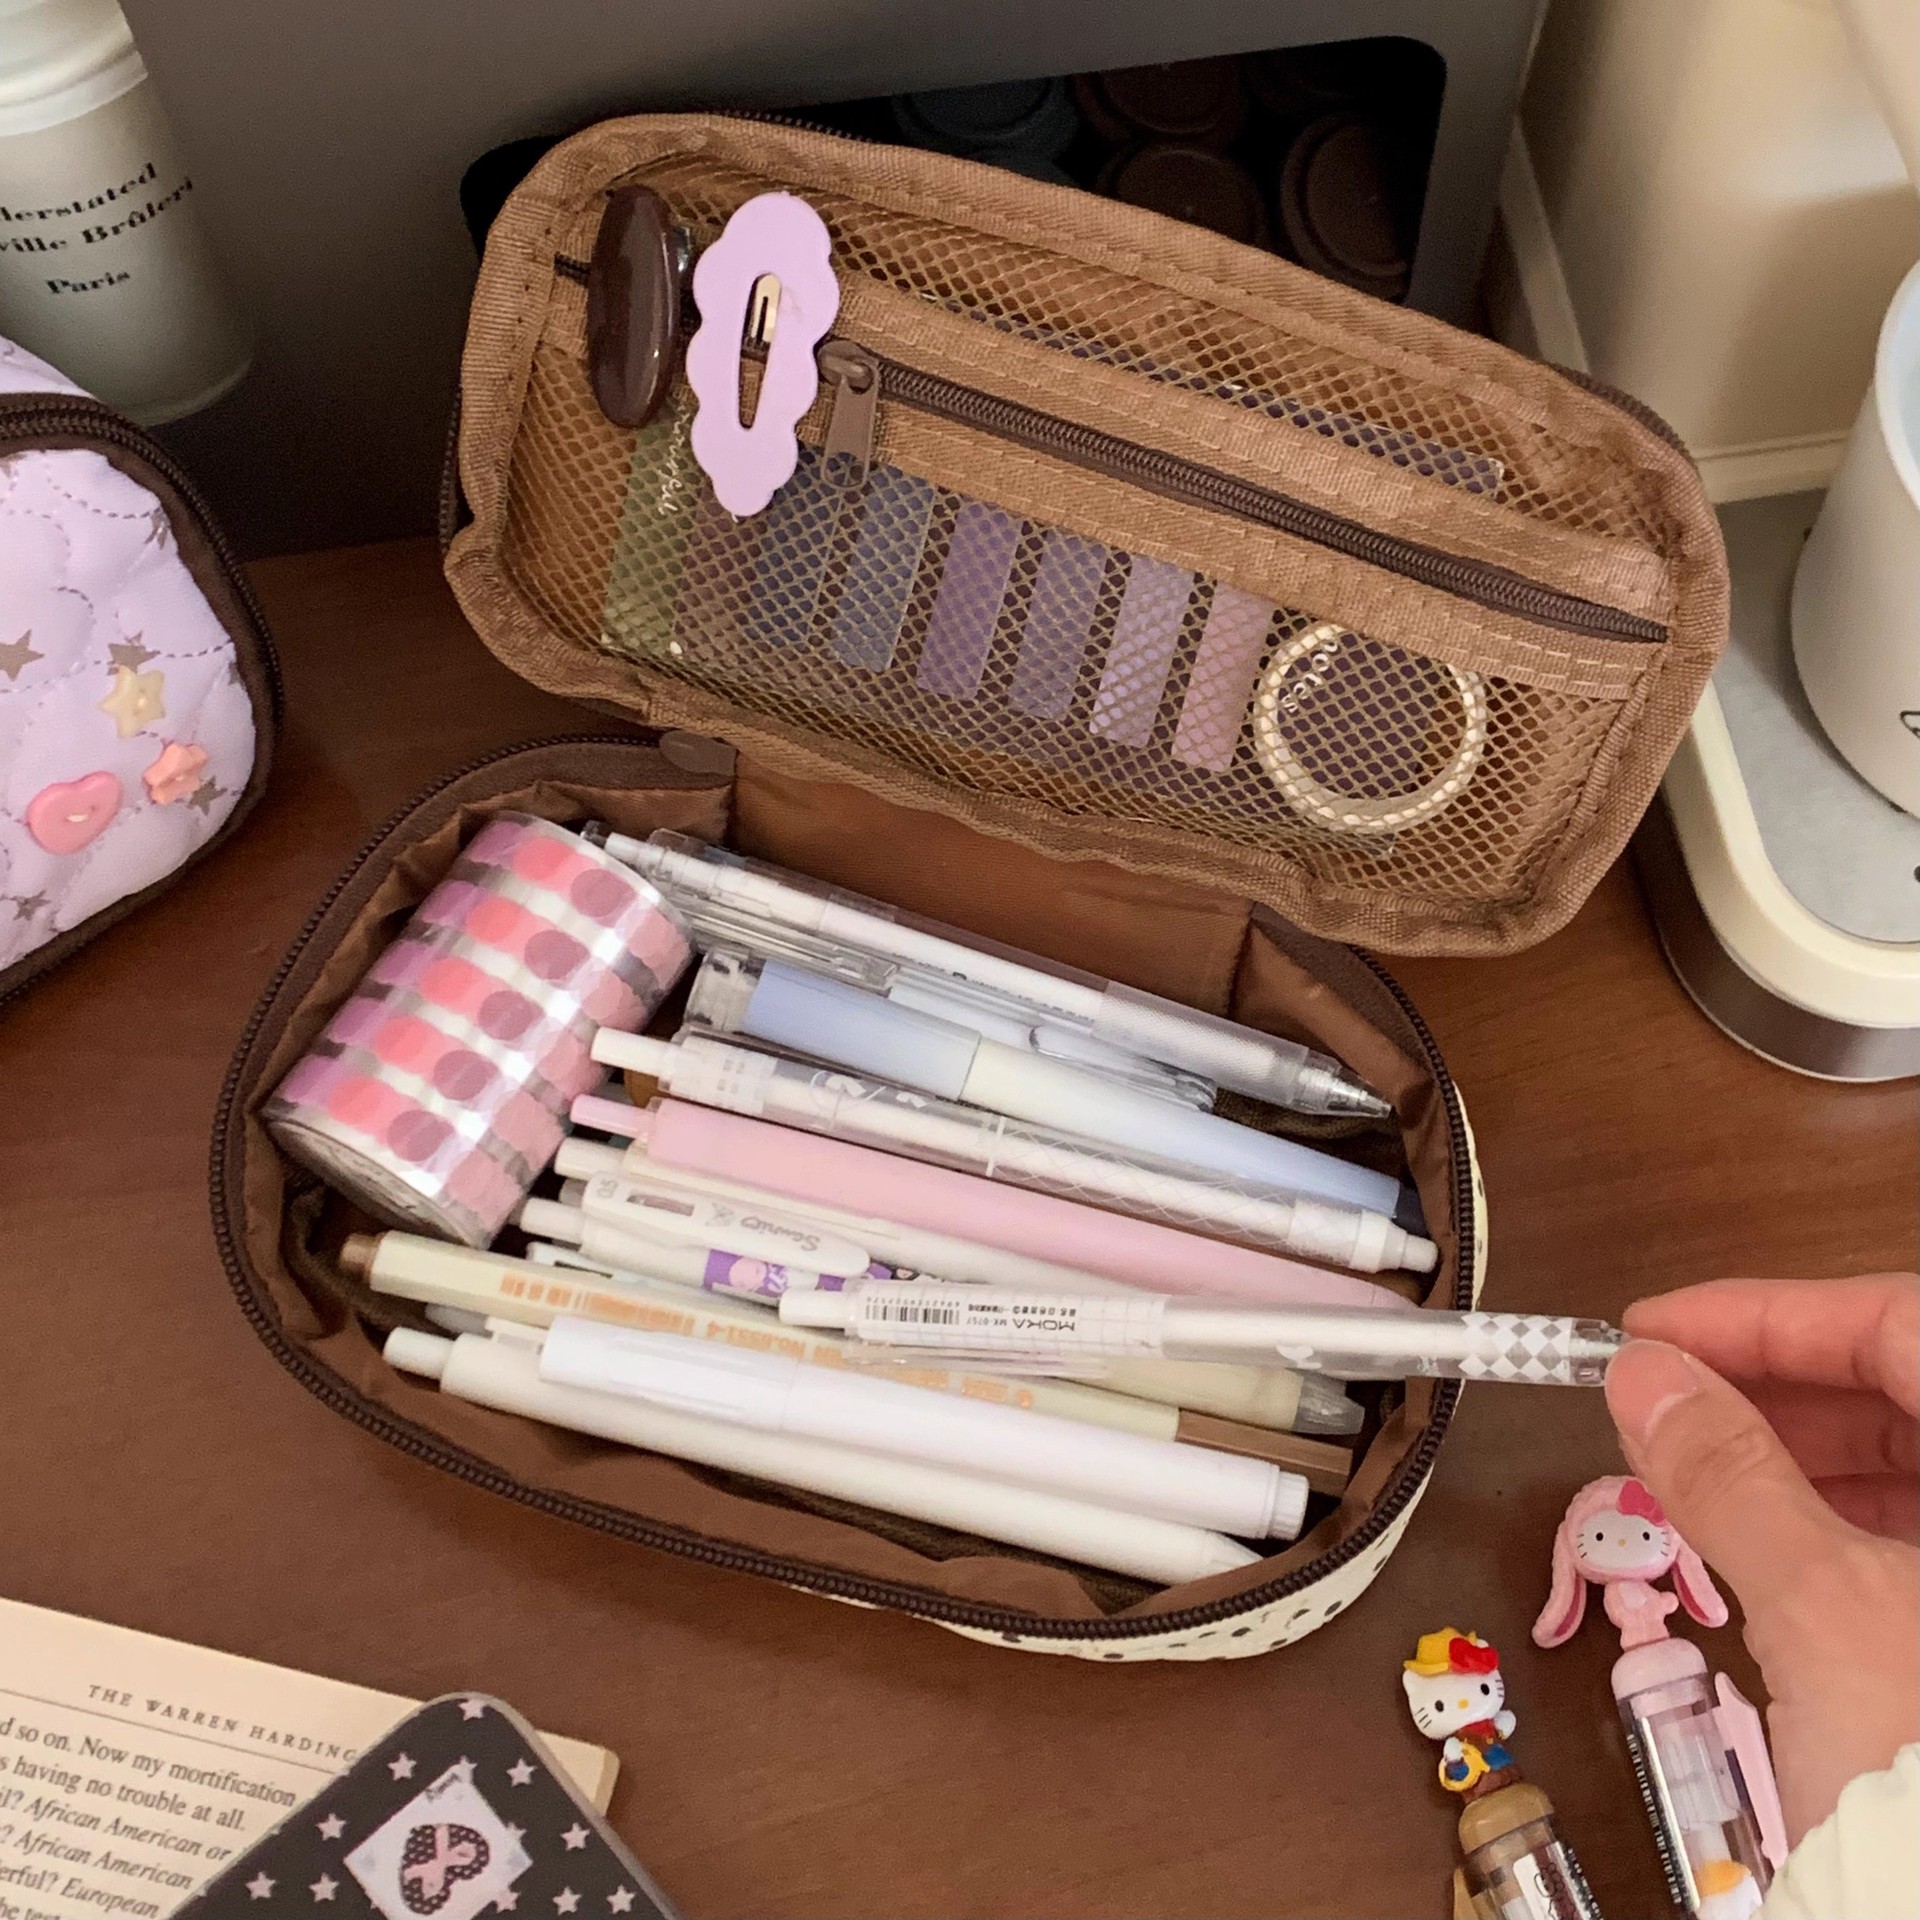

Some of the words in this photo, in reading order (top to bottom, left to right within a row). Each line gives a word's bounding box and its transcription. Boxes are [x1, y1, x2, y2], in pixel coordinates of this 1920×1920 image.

[46, 271, 131, 294] Paris
[1011, 1318, 1076, 1333] MOKA
[88, 1684, 133, 1707] THE
[145, 1698, 239, 1733] WARREN
[249, 1726, 358, 1763] HARDING
[13, 1755, 82, 1794] having
[86, 1779, 111, 1796] no
[117, 1784, 187, 1816] trouble
[192, 1803, 211, 1822] at
[216, 1807, 246, 1831] all.
[15, 1725, 39, 1742] so
[43, 1732, 71, 1752] on.
[79, 1736, 129, 1763] Now
[131, 1753, 164, 1777] my
[168, 1763, 297, 1807] mortification
[13, 1830, 92, 1863] African
[94, 1851, 194, 1891] American
[23, 1797, 101, 1830] African
[104, 1817, 201, 1855] American
[205, 1845, 232, 1862] or
[0, 1865, 59, 1893] erful?
[60, 1877, 160, 1919] European
